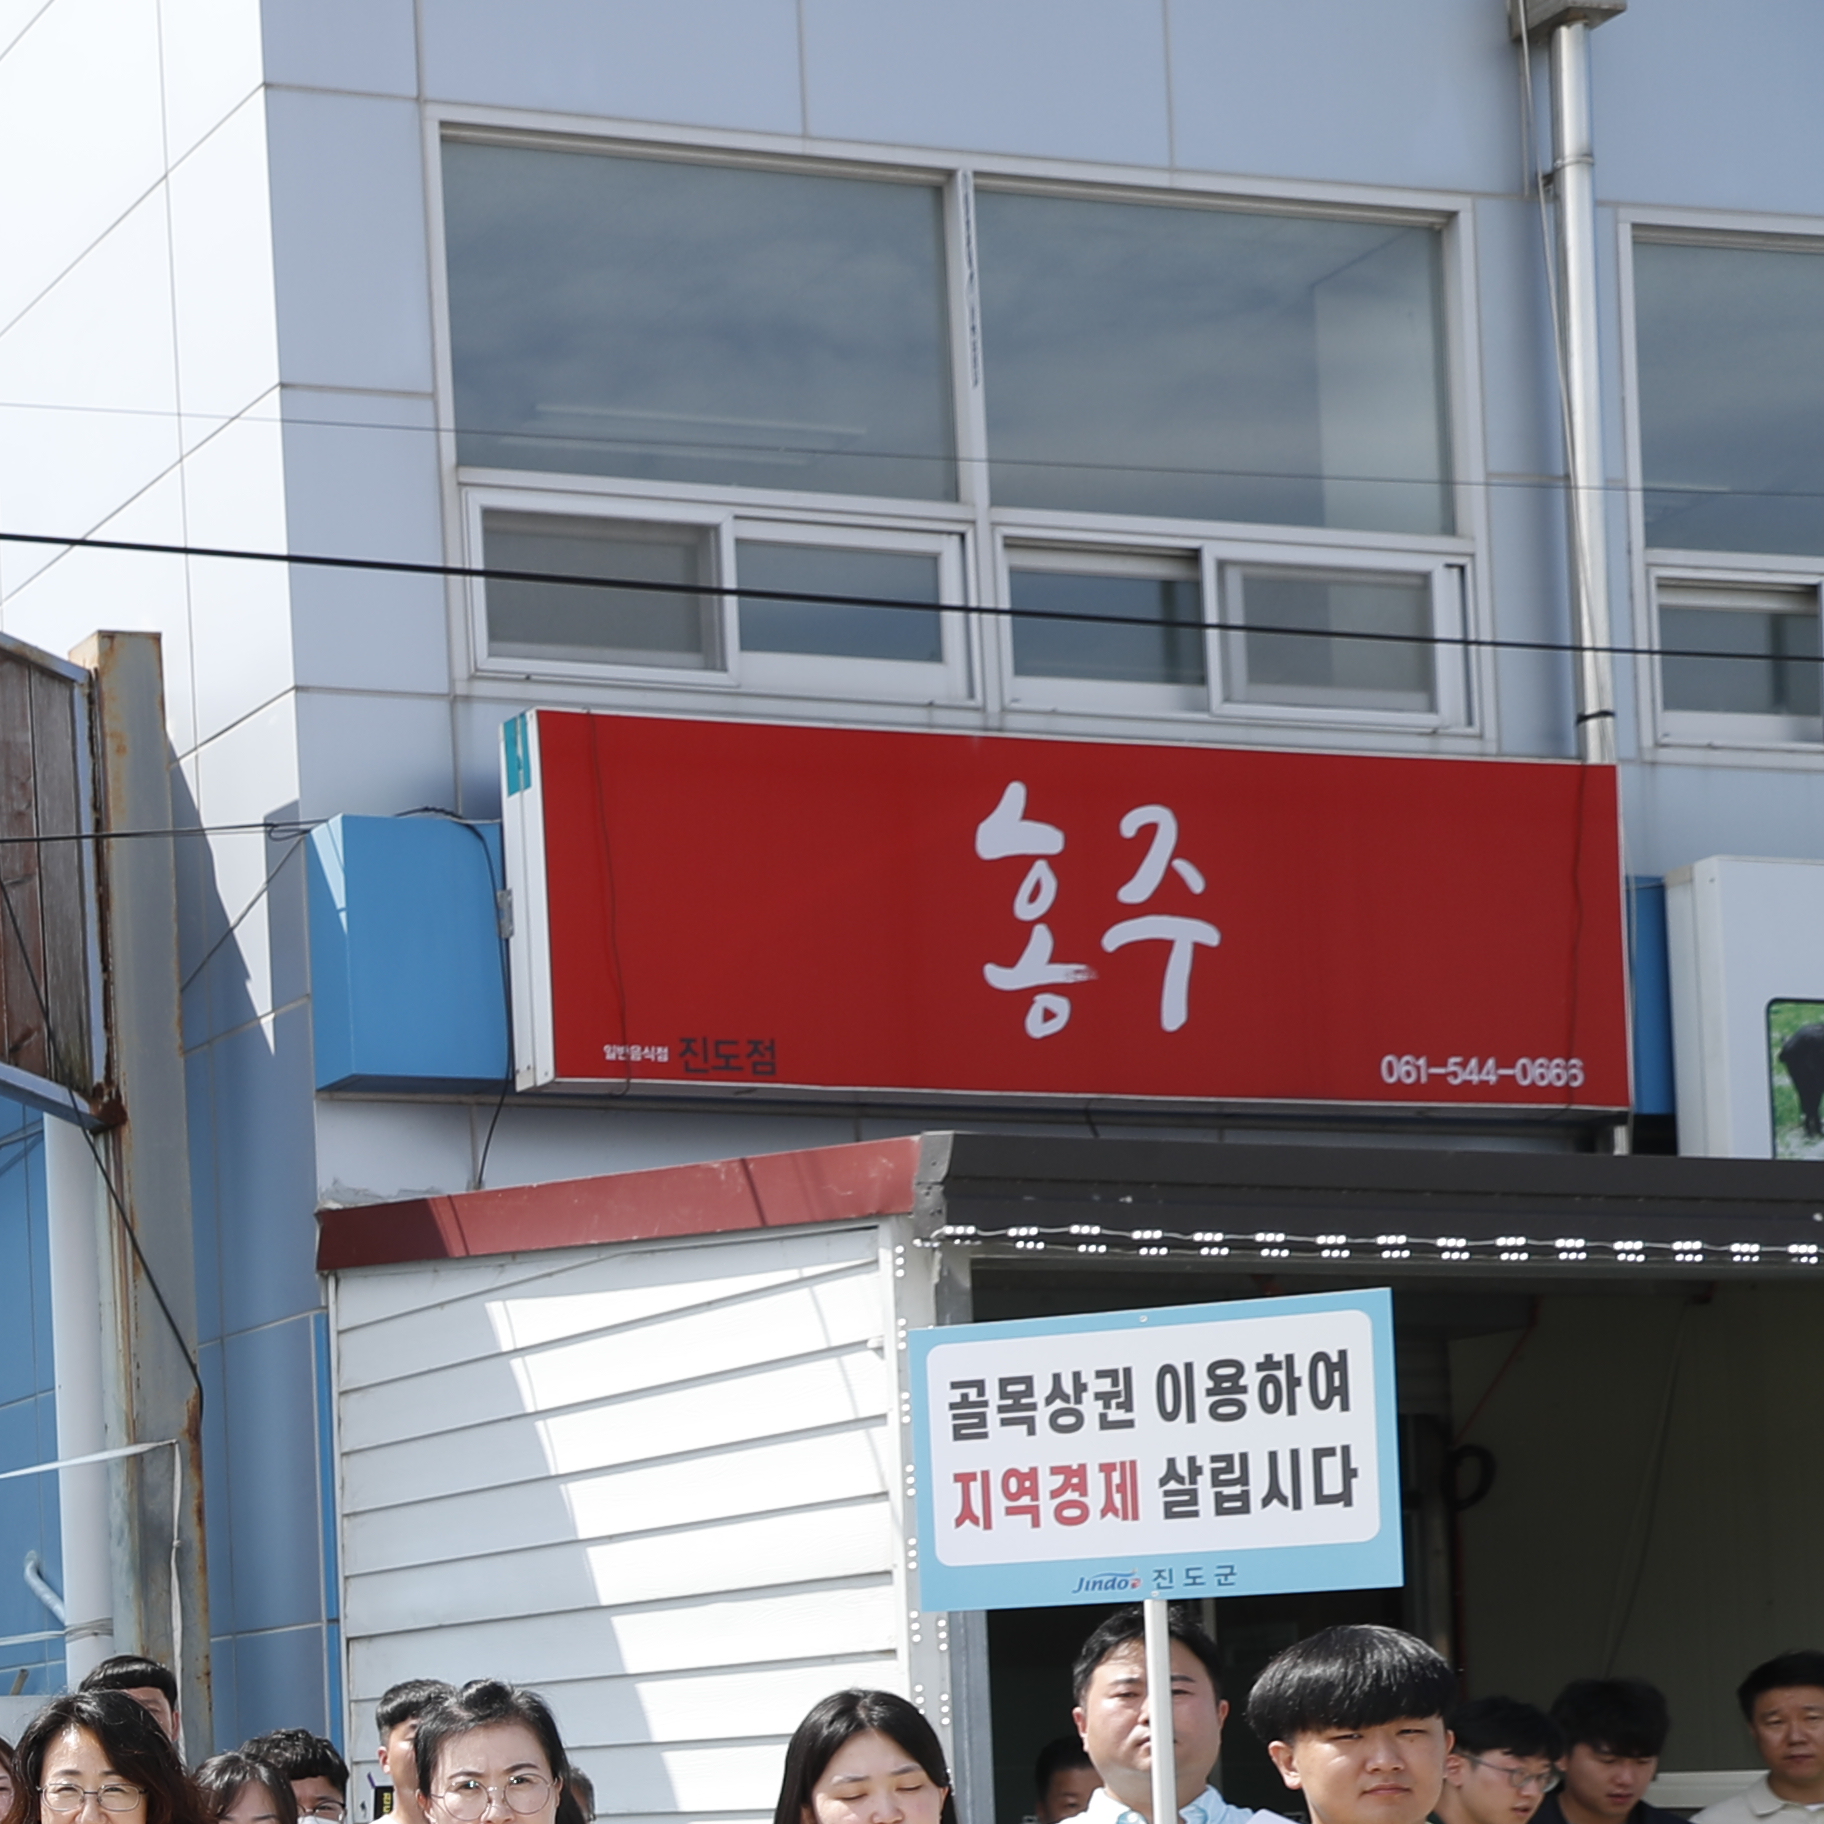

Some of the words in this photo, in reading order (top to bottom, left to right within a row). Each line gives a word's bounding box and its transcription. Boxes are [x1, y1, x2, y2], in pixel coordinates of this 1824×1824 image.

[975, 780, 1221, 1038] 홍주
[679, 1037, 777, 1076] 진도점
[1380, 1053, 1585, 1088] 061-544-0666
[949, 1365, 1135, 1443] 골목상권
[1155, 1348, 1353, 1425] 이용하여
[952, 1459, 1141, 1532] 지역경제
[1157, 1443, 1359, 1520] 살립시다
[1072, 1576, 1130, 1594] Jindo
[1152, 1563, 1238, 1590] 진도군
